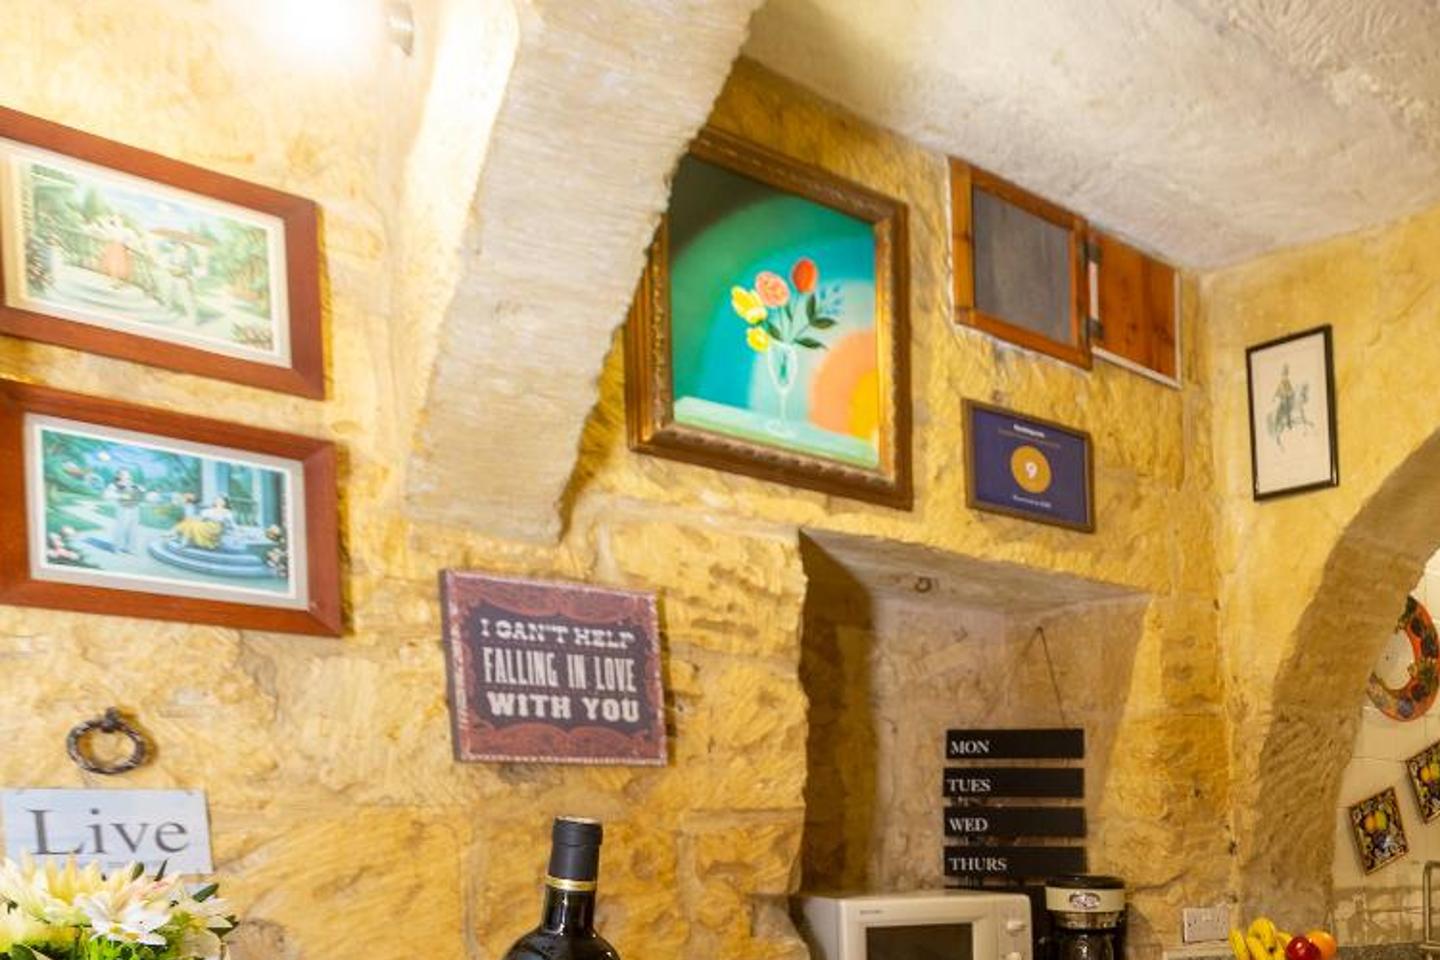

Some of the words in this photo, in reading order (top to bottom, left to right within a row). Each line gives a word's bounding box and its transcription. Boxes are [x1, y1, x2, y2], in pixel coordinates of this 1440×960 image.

[479, 618, 491, 638] I
[495, 619, 569, 644] CAN'T
[573, 627, 636, 650] HELP
[483, 646, 559, 688] FALLING
[566, 653, 588, 691] IN
[595, 656, 637, 693] LOVE
[485, 691, 572, 720] WITH
[581, 697, 641, 723] YOU
[950, 739, 990, 755] MON
[946, 778, 992, 793] TUES
[25, 807, 190, 856] Live
[949, 816, 989, 833] WED
[948, 856, 1008, 872] THURS
